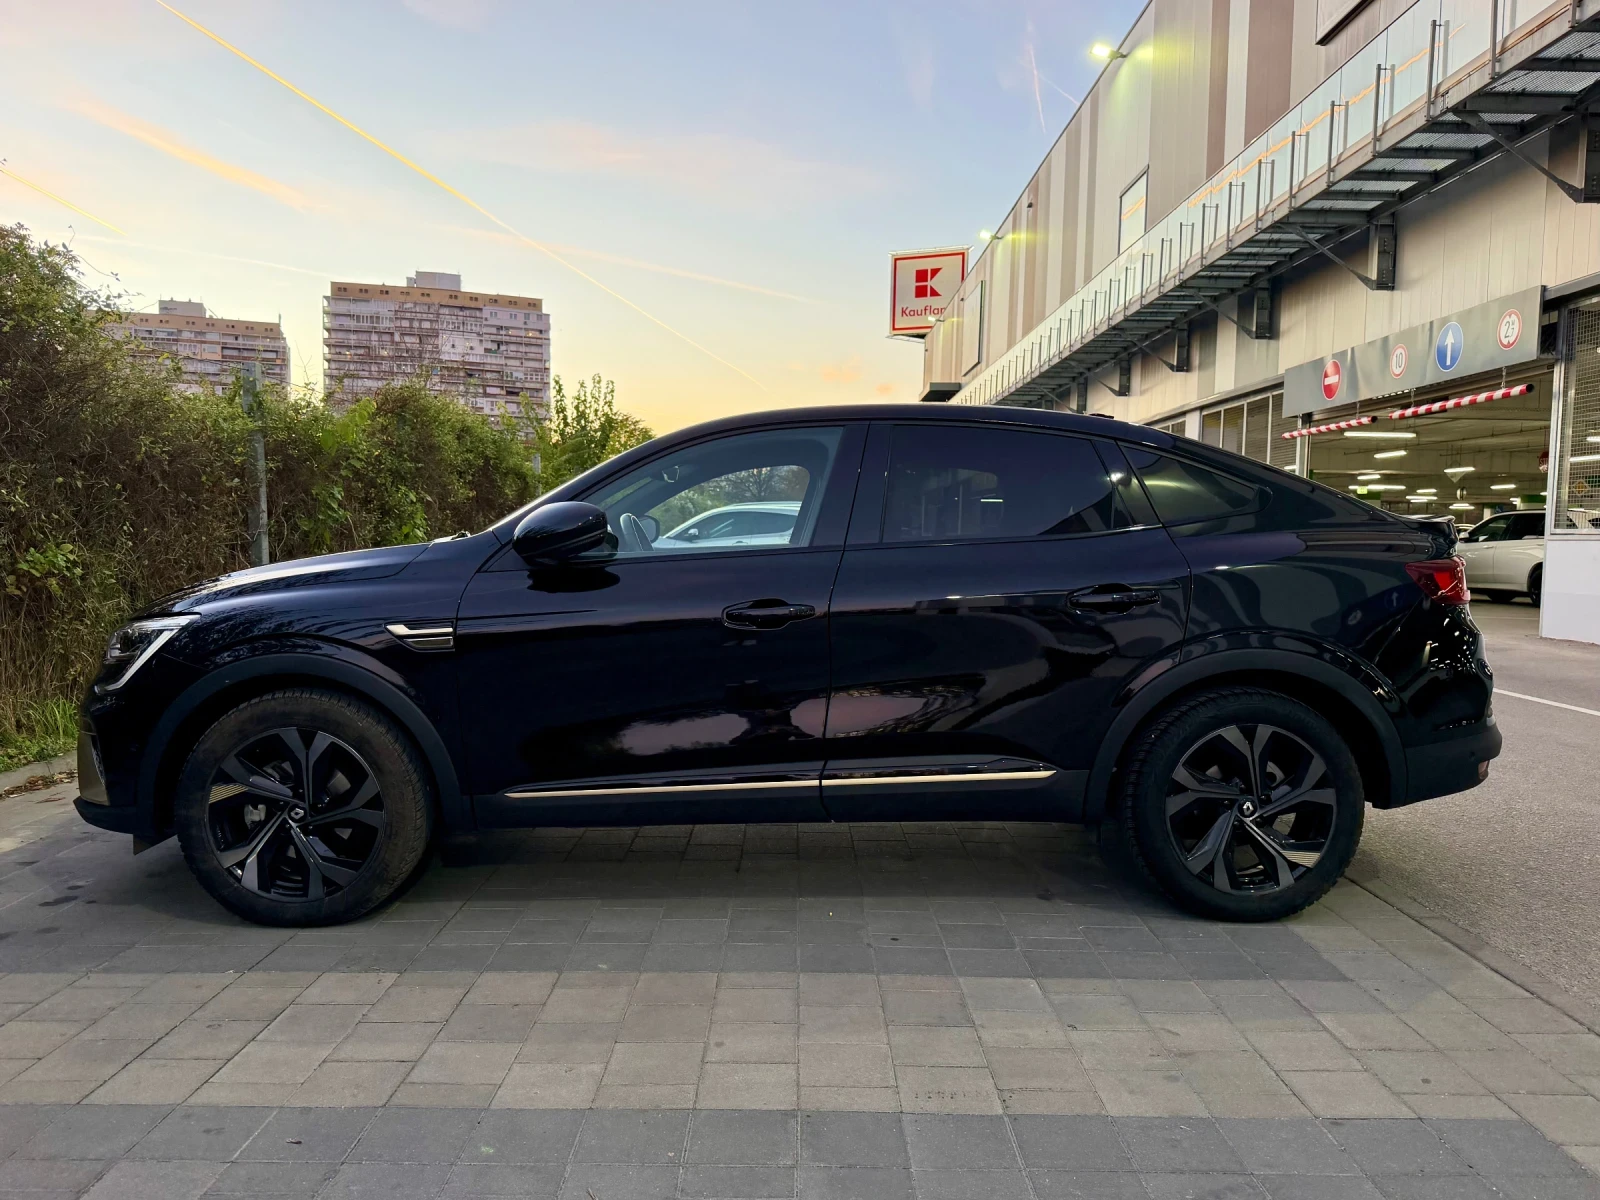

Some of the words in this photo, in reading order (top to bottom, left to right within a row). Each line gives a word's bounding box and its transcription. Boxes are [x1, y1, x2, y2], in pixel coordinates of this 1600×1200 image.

[915, 267, 943, 298] K
[901, 305, 946, 317] Kauflan
[1396, 352, 1403, 370] 10
